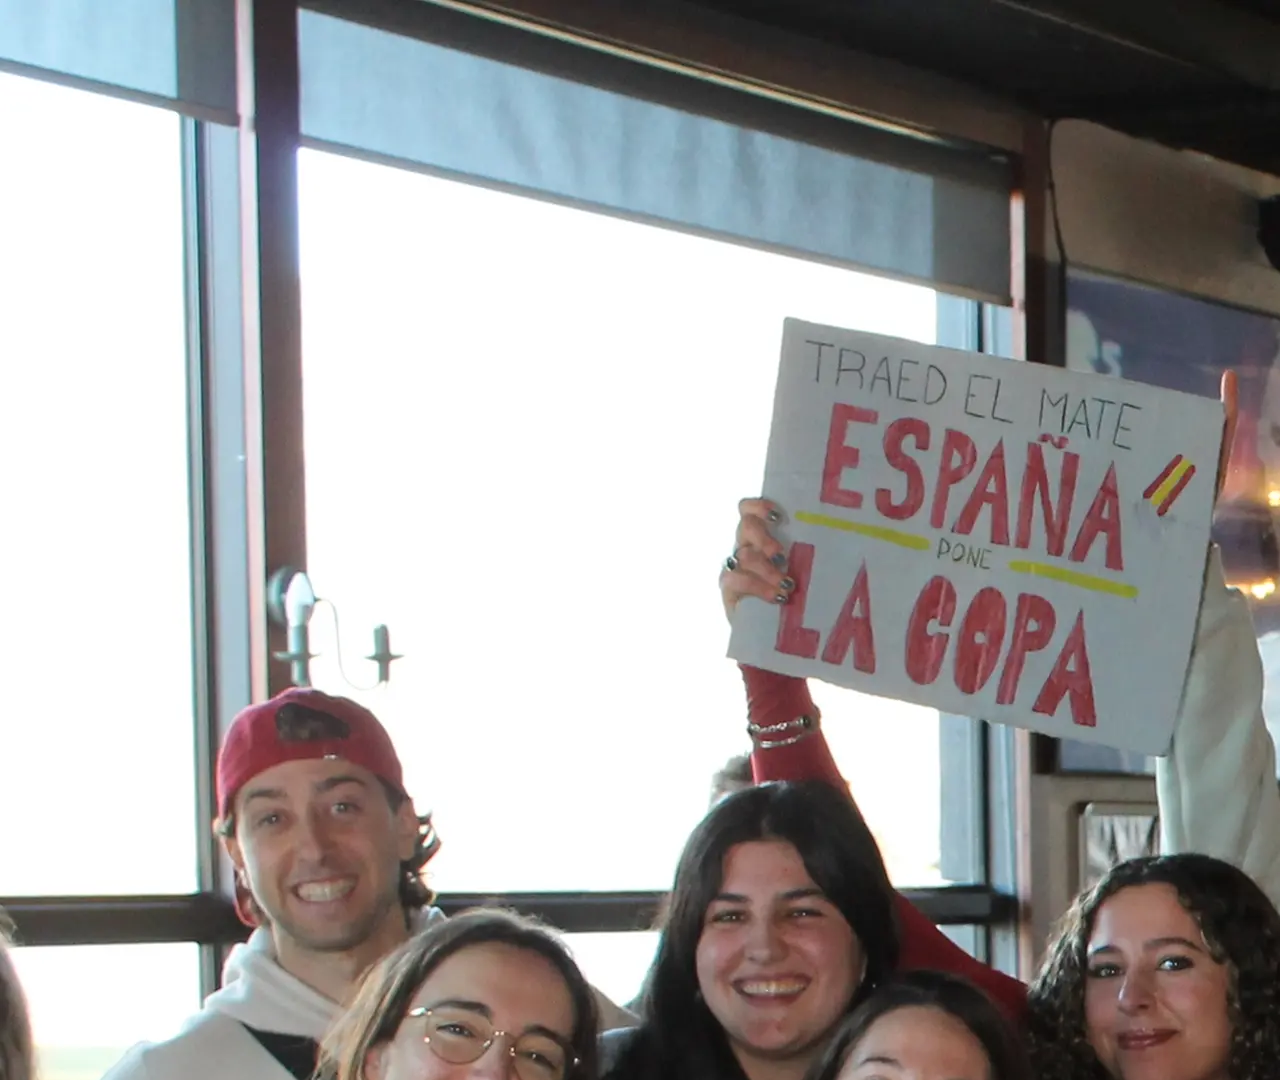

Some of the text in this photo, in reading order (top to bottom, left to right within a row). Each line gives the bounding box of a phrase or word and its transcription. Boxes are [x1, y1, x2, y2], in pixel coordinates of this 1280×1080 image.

[806, 340, 1142, 451] TRAED EL MATE
[819, 402, 1124, 572] ESPAÑA
[936, 537, 991, 571] PONE
[774, 541, 1097, 728] LA COPA
